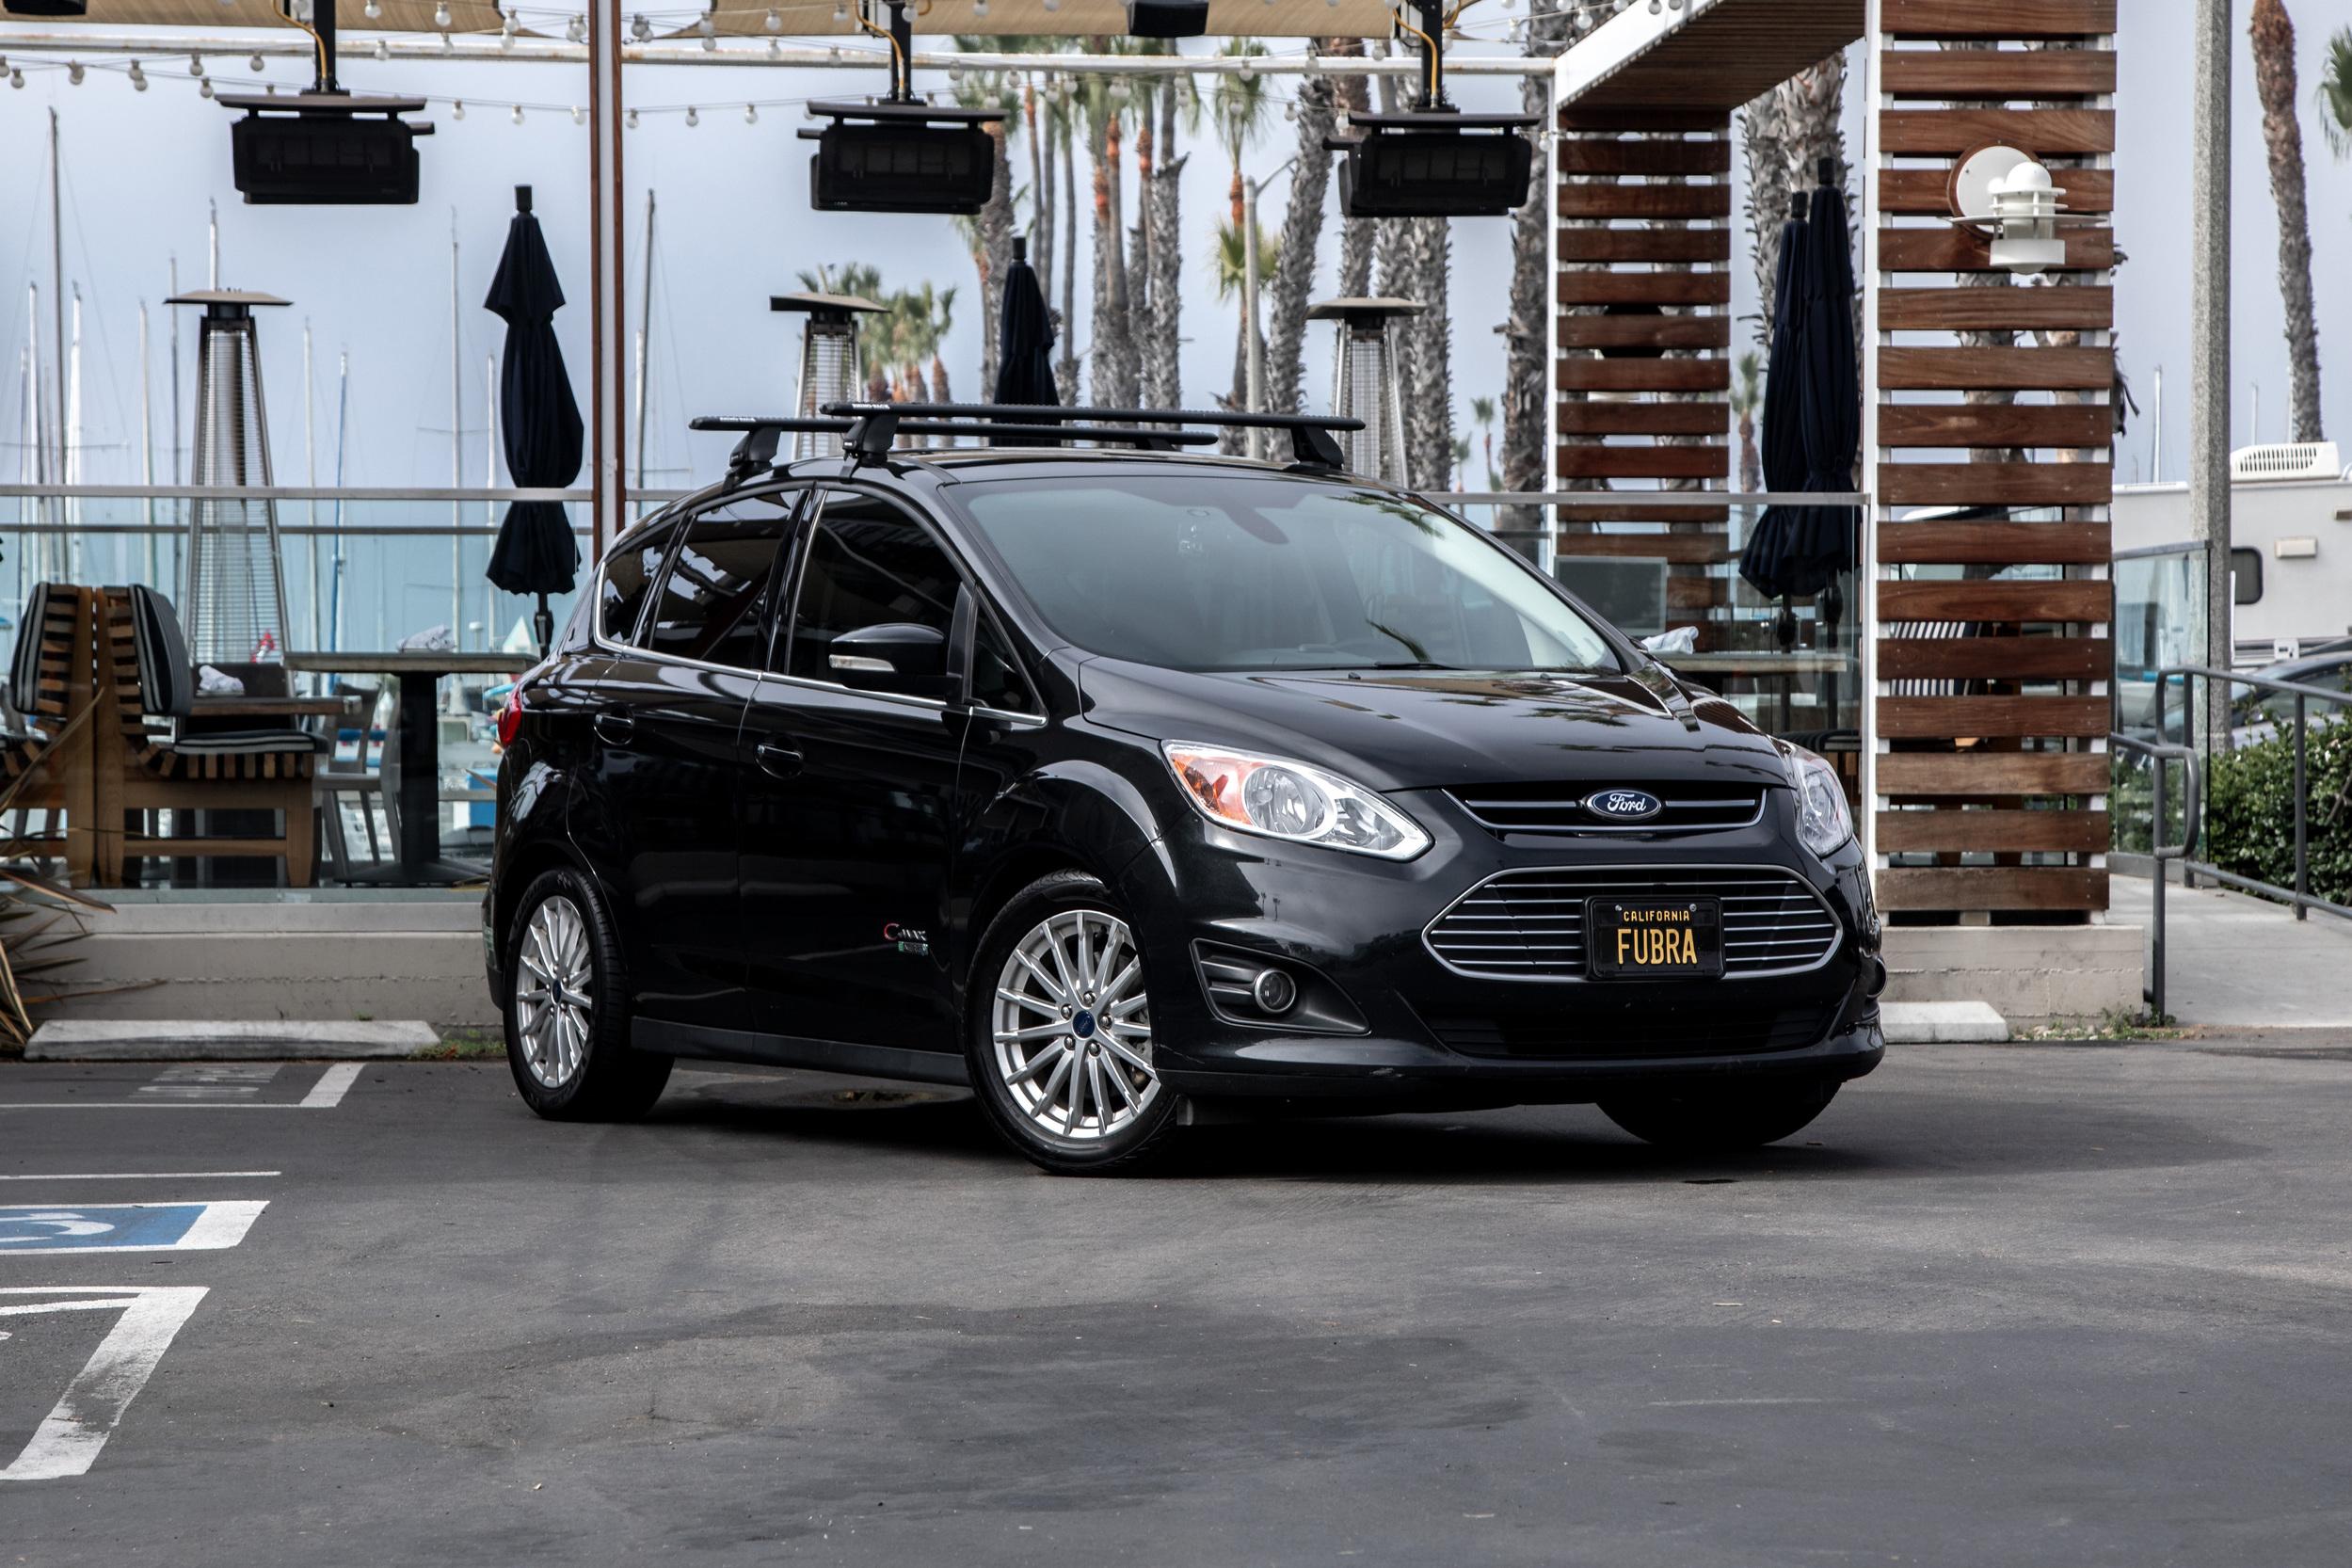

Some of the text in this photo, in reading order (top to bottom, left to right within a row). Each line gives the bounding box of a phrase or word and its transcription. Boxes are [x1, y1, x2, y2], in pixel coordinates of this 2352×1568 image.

[1607, 792, 1647, 812] Ford
[1623, 910, 1690, 922] CALIFORNIA
[1617, 928, 1698, 965] FUBRA
